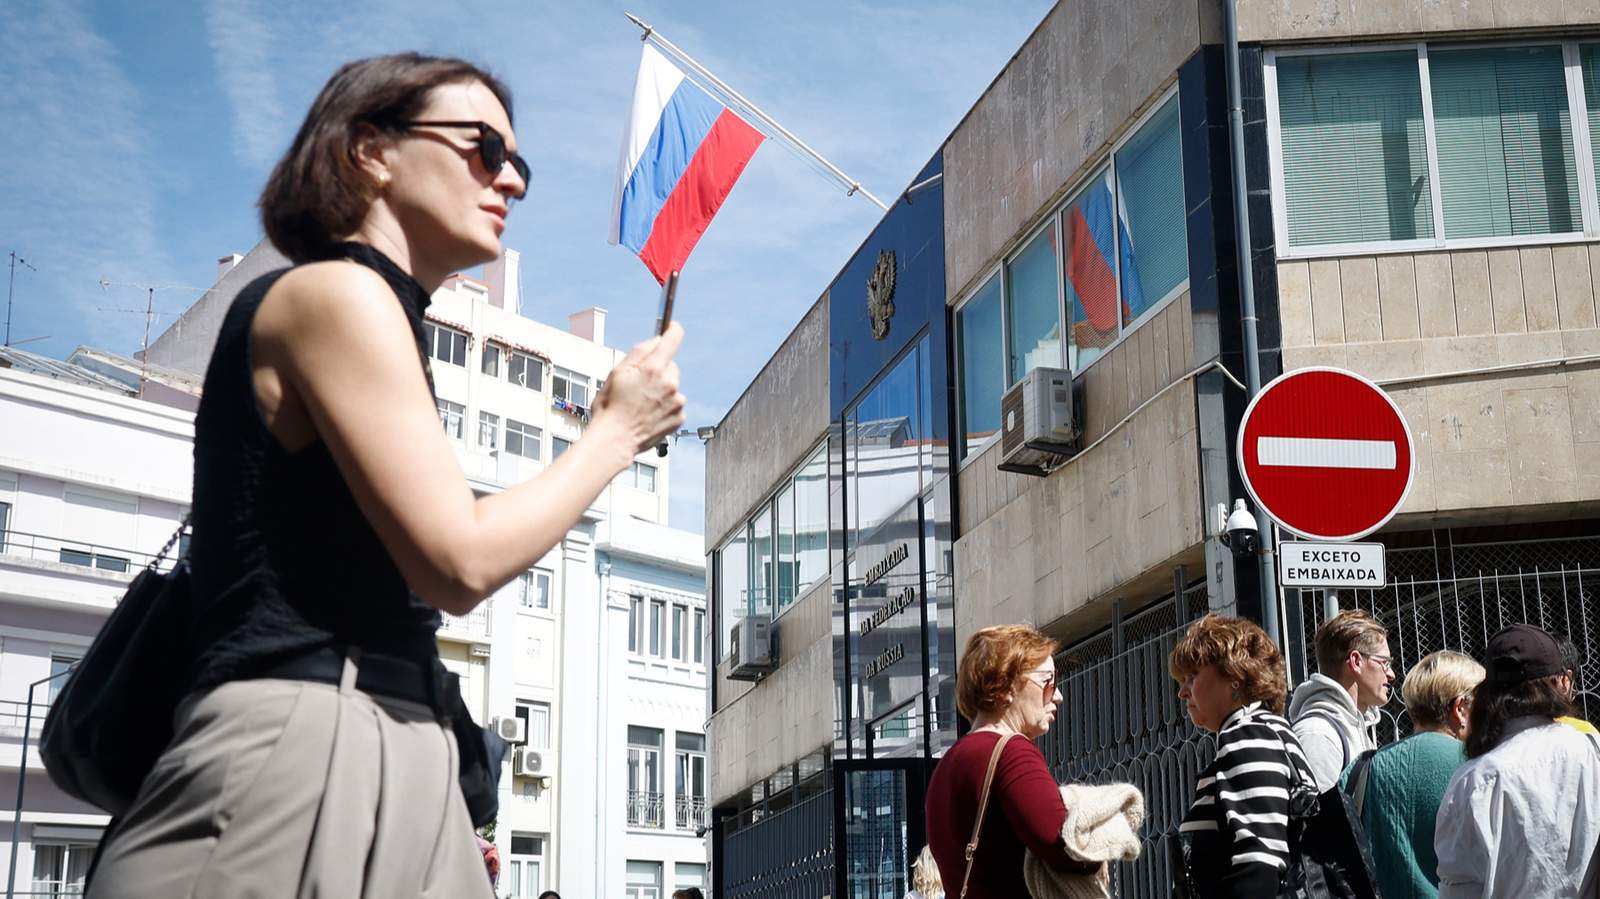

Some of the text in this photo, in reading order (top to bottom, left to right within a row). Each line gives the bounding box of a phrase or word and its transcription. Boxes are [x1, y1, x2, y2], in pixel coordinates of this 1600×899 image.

[1302, 551, 1361, 563] EXCETO
[1287, 568, 1377, 580] EMBAIXADA
[865, 643, 905, 680] DA RÚSSIA
